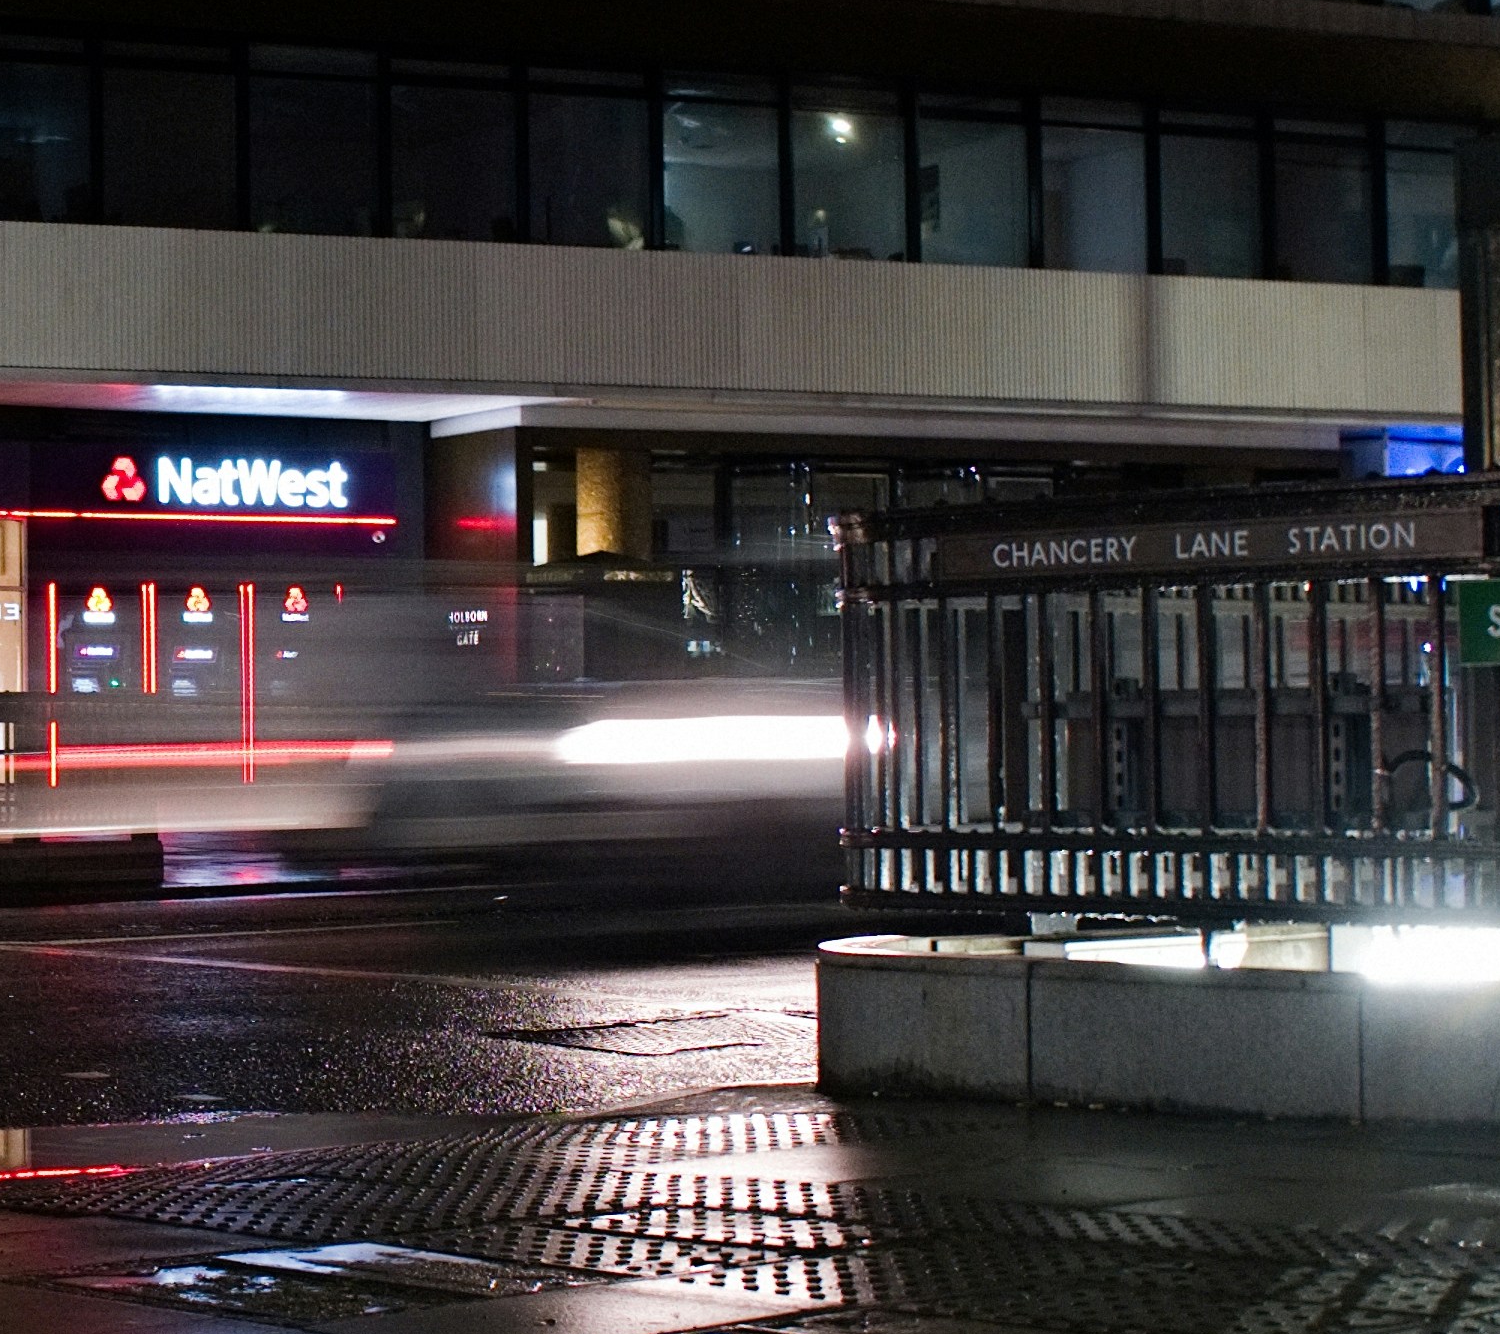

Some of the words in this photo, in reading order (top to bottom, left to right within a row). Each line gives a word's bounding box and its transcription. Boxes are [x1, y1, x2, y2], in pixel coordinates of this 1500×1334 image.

[157, 456, 348, 508] NatWest
[993, 535, 1137, 567] CHANCERY
[1175, 530, 1249, 560] LANE
[1287, 522, 1416, 555] STATION
